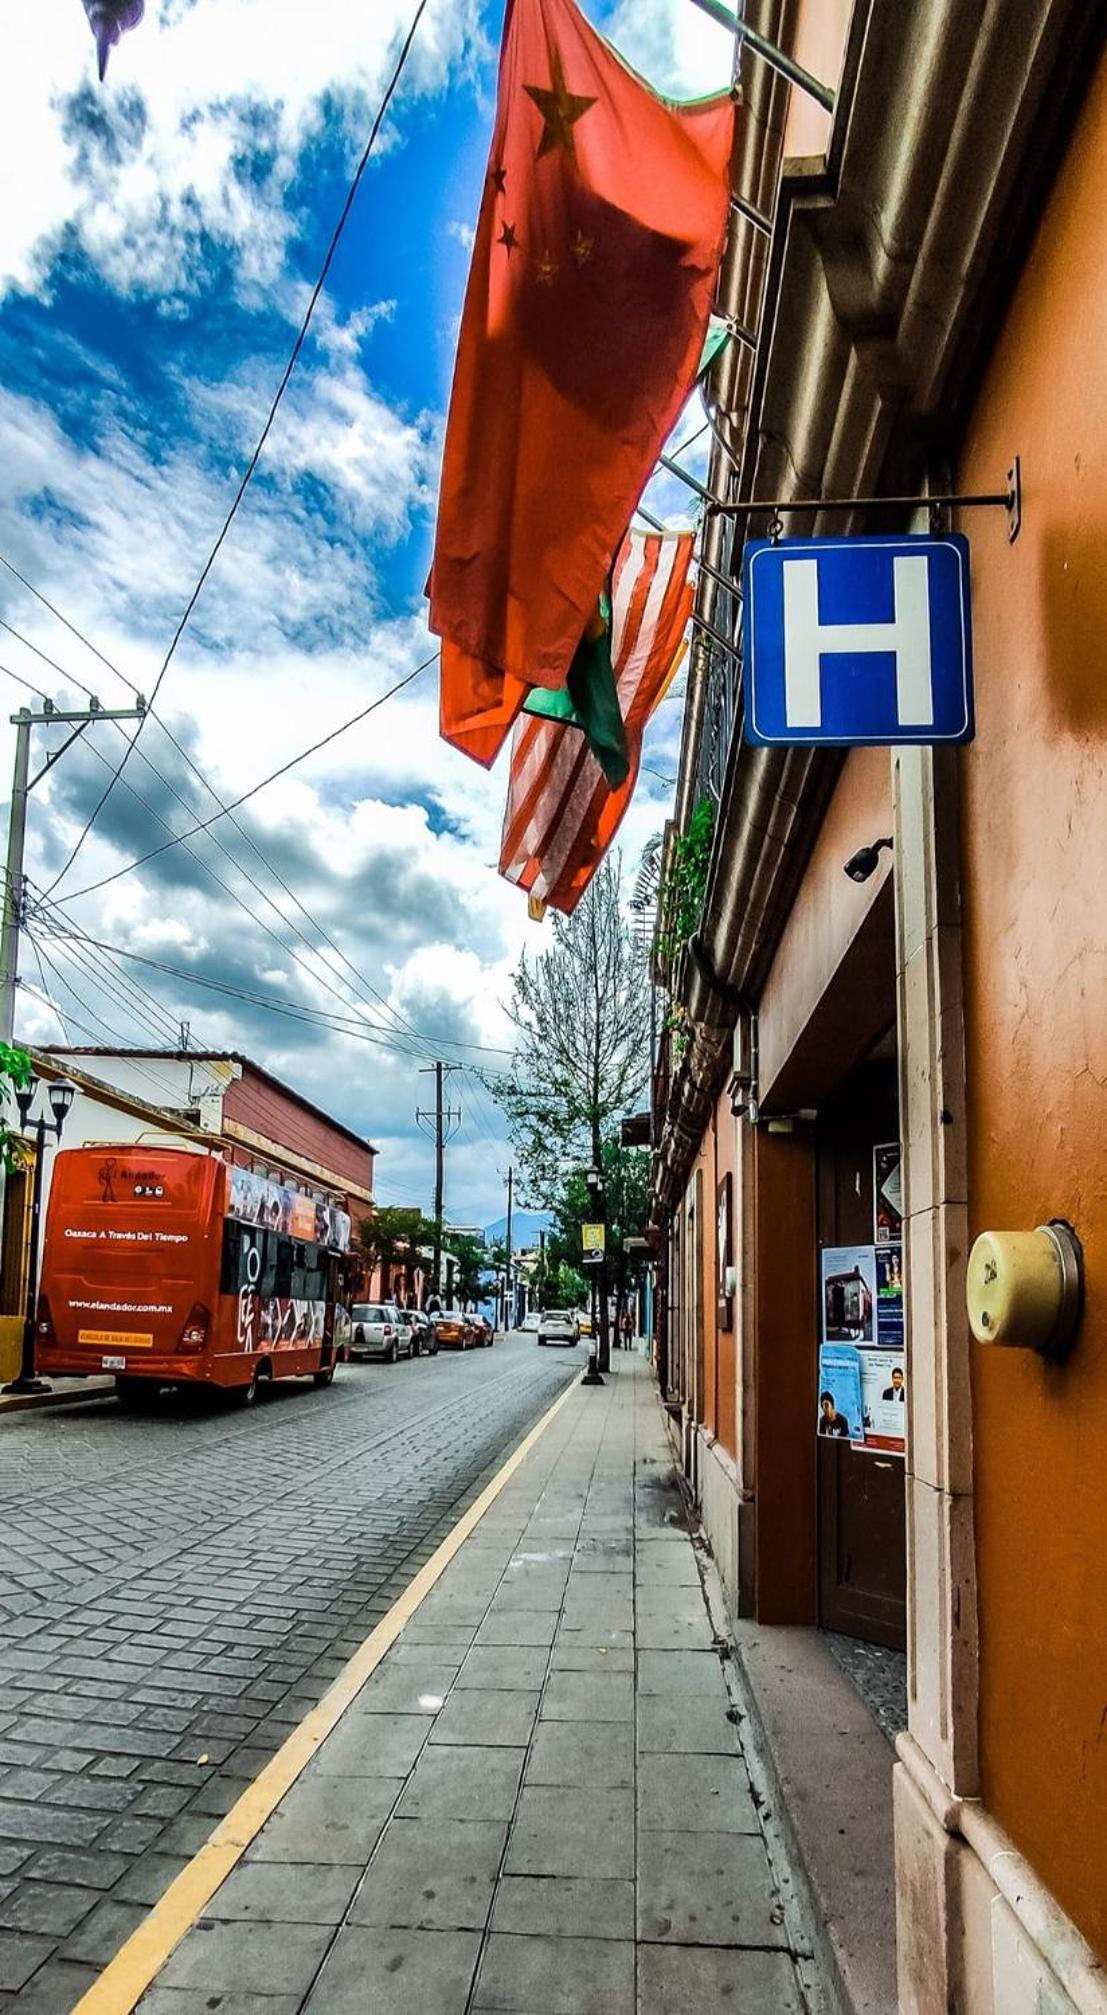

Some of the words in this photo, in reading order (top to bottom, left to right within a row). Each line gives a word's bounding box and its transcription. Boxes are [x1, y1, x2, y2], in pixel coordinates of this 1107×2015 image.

[783, 556, 934, 728] H
[64, 1229, 97, 1238] Oaxaca
[99, 1230, 107, 1239] A
[137, 1232, 153, 1241] Del
[155, 1233, 188, 1243] Tiempo
[68, 1300, 173, 1313] www.elandador.com.mx
